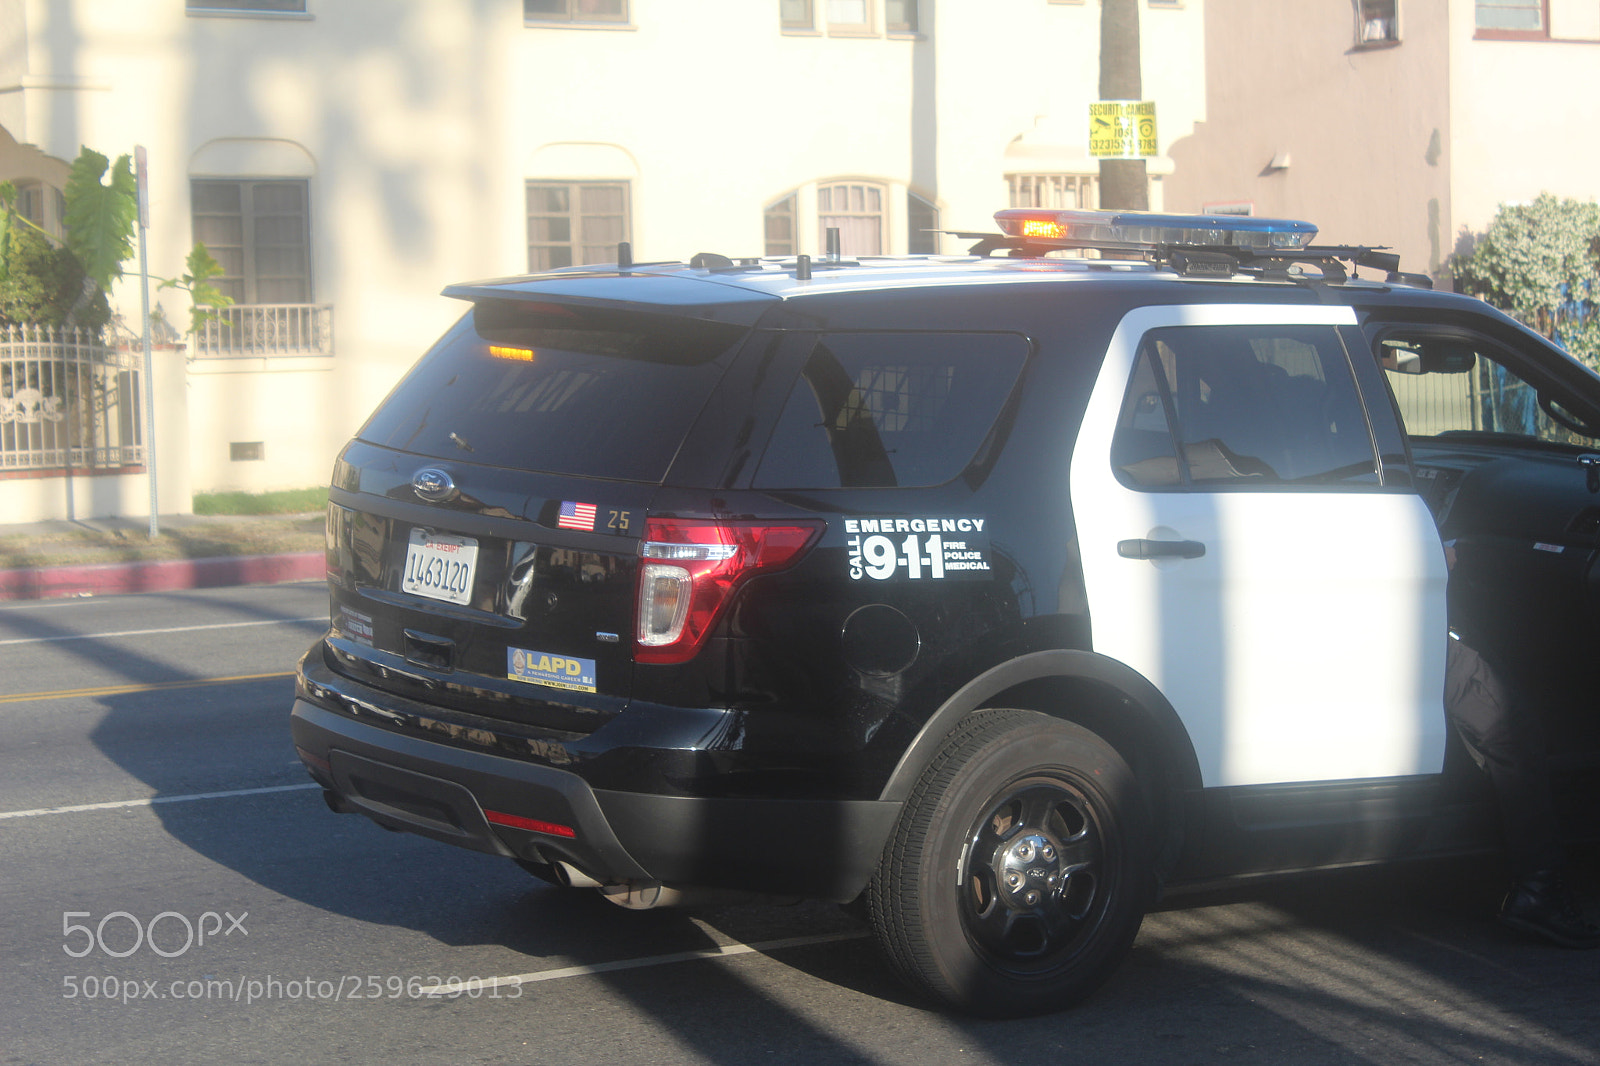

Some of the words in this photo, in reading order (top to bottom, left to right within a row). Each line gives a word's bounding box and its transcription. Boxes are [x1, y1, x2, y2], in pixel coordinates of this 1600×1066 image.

[1089, 104, 1124, 116] SECURITY
[607, 510, 630, 529] 25
[845, 518, 985, 533] EMERGENCY
[425, 539, 434, 549] CA
[436, 542, 461, 554] EXEMPT
[943, 541, 967, 550] FIRE
[848, 535, 863, 580] CALL
[862, 534, 945, 580] 9-1-1
[944, 551, 982, 560] POLICE
[407, 553, 469, 594] 1463120
[944, 561, 991, 571] MEDICAL
[526, 653, 581, 676] LAPD
